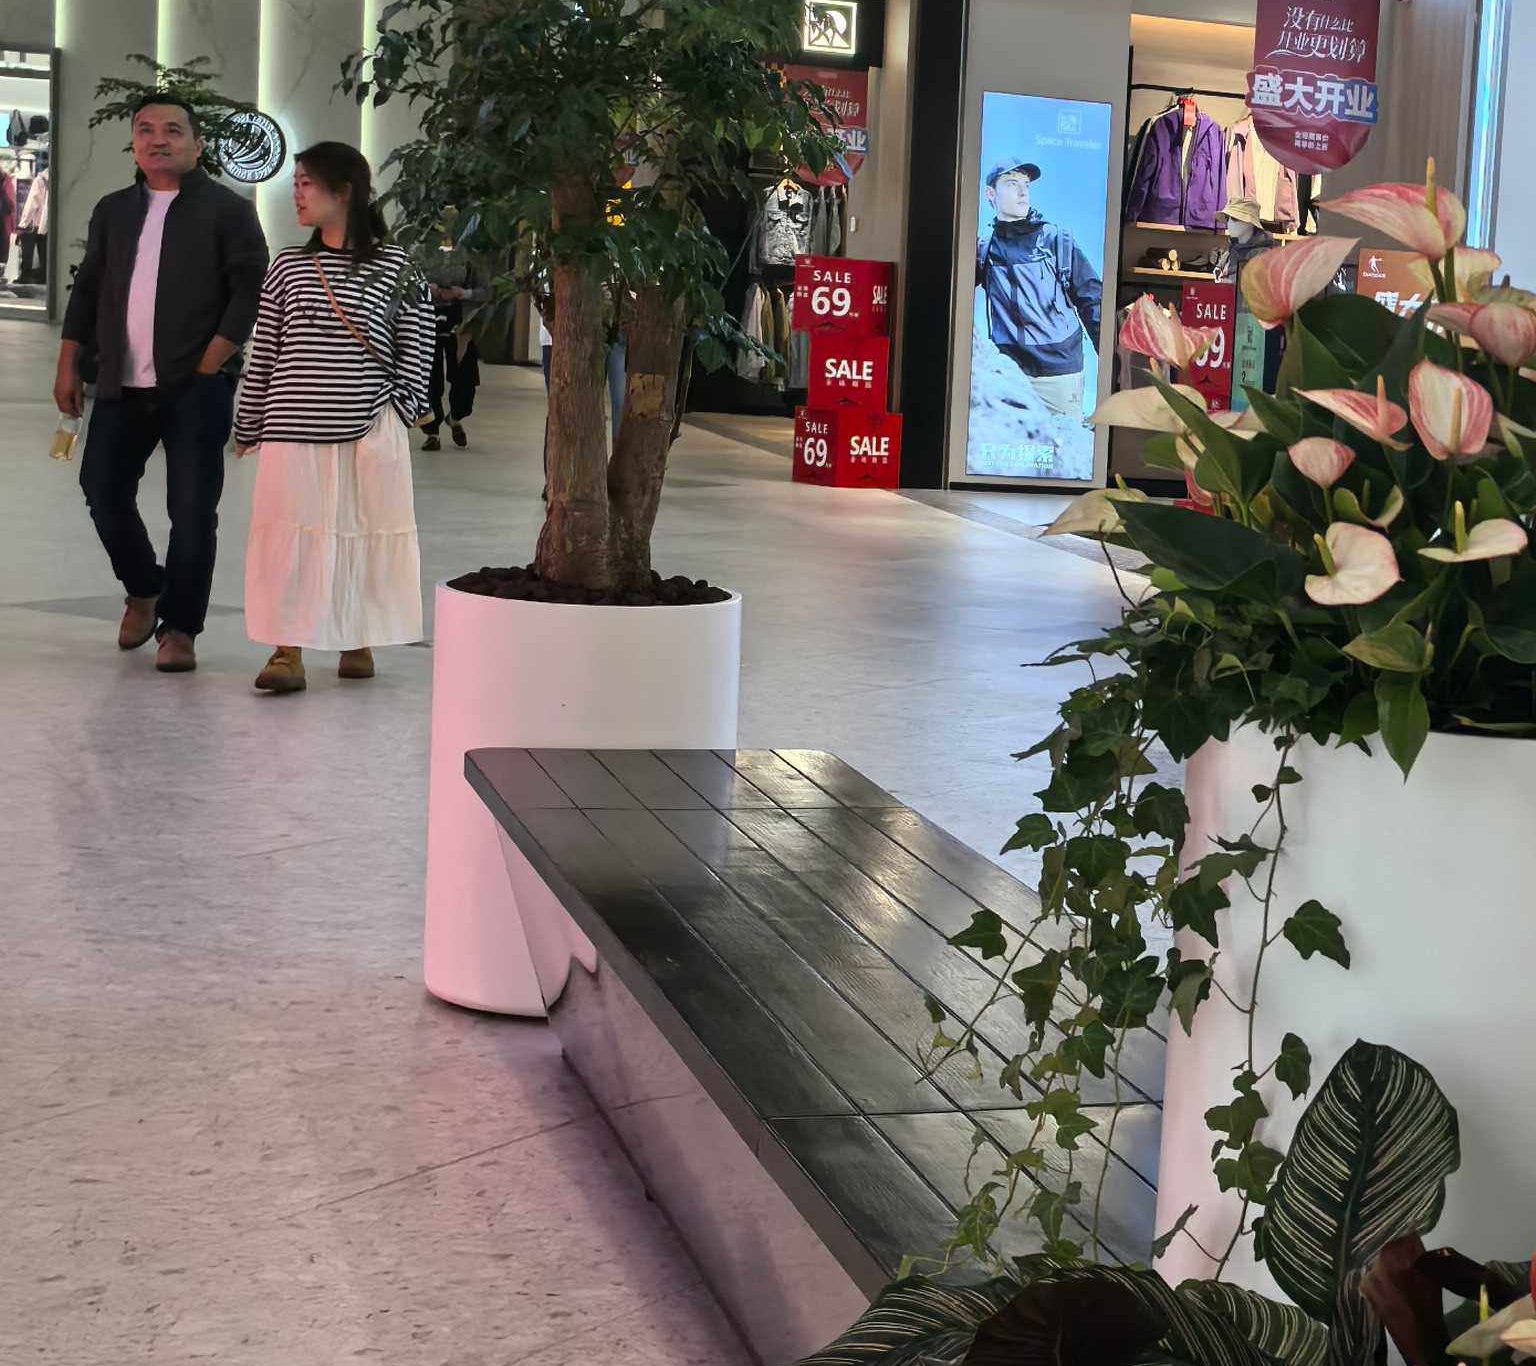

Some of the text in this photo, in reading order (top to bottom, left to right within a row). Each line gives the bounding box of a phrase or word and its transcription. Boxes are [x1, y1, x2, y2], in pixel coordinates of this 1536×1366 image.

[1250, 72, 1375, 119] 盛大开业
[813, 270, 852, 284] SALE
[811, 286, 851, 317] 69
[1196, 303, 1227, 321] SALE
[825, 358, 874, 381] SALE
[805, 421, 828, 434] SALE
[803, 437, 828, 467] 69
[850, 435, 890, 456] SALE
